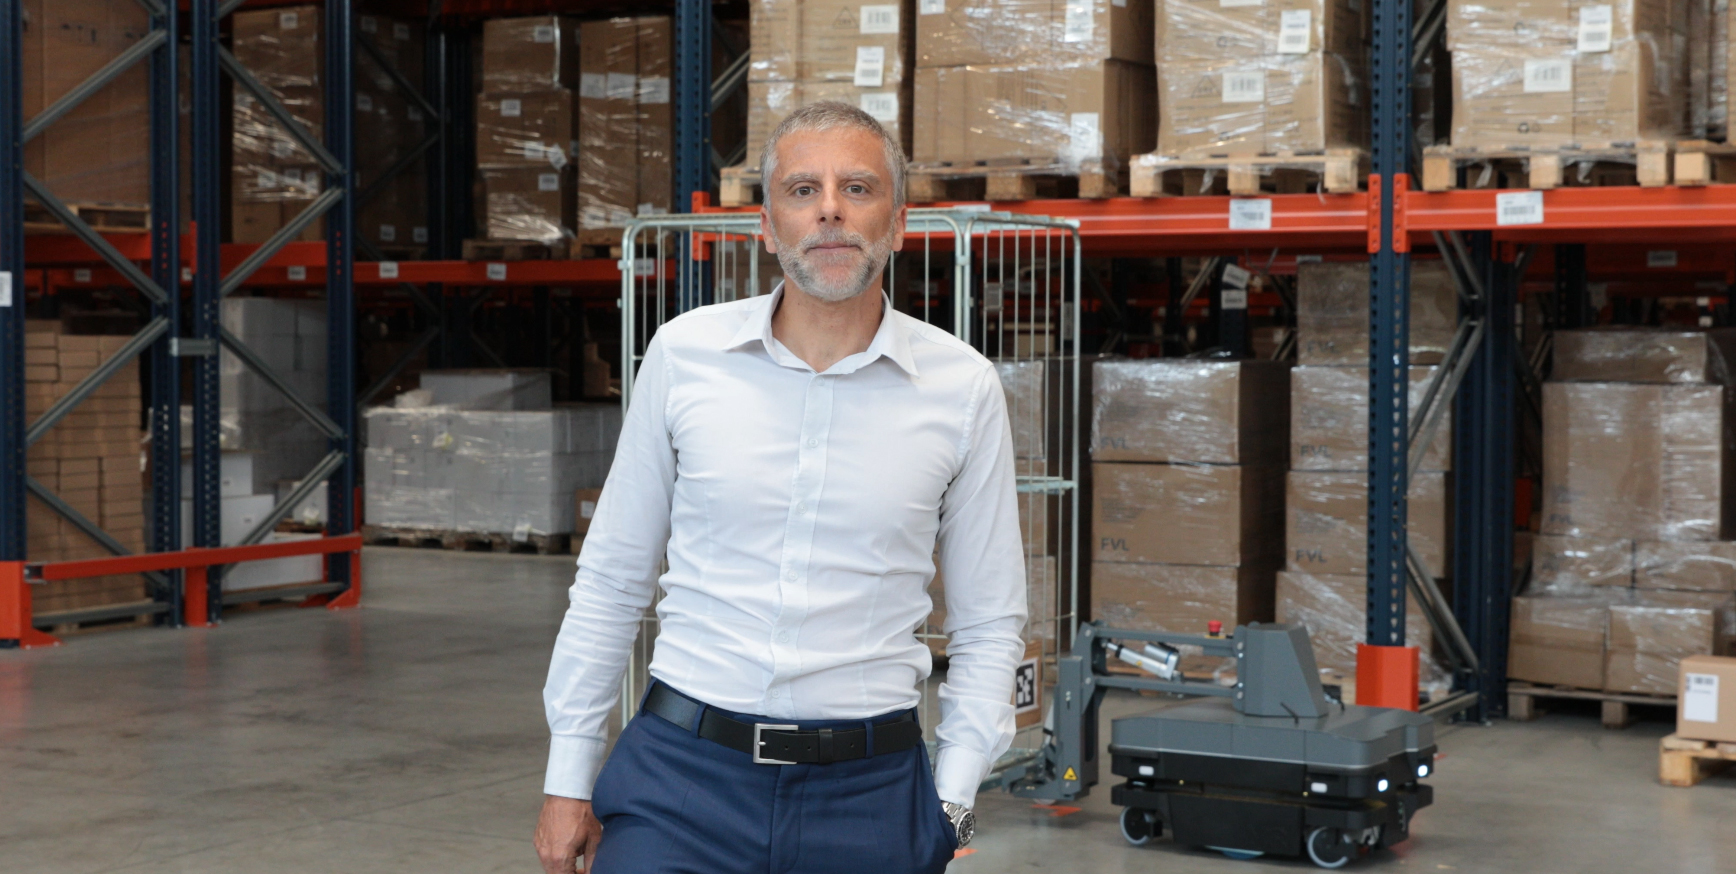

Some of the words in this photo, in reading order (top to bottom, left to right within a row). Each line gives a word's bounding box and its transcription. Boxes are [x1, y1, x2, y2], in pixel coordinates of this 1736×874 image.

[1100, 436, 1130, 450] FVL
[1300, 445, 1332, 458] FVL
[1100, 537, 1129, 551] FVL
[1295, 549, 1327, 563] FVL
